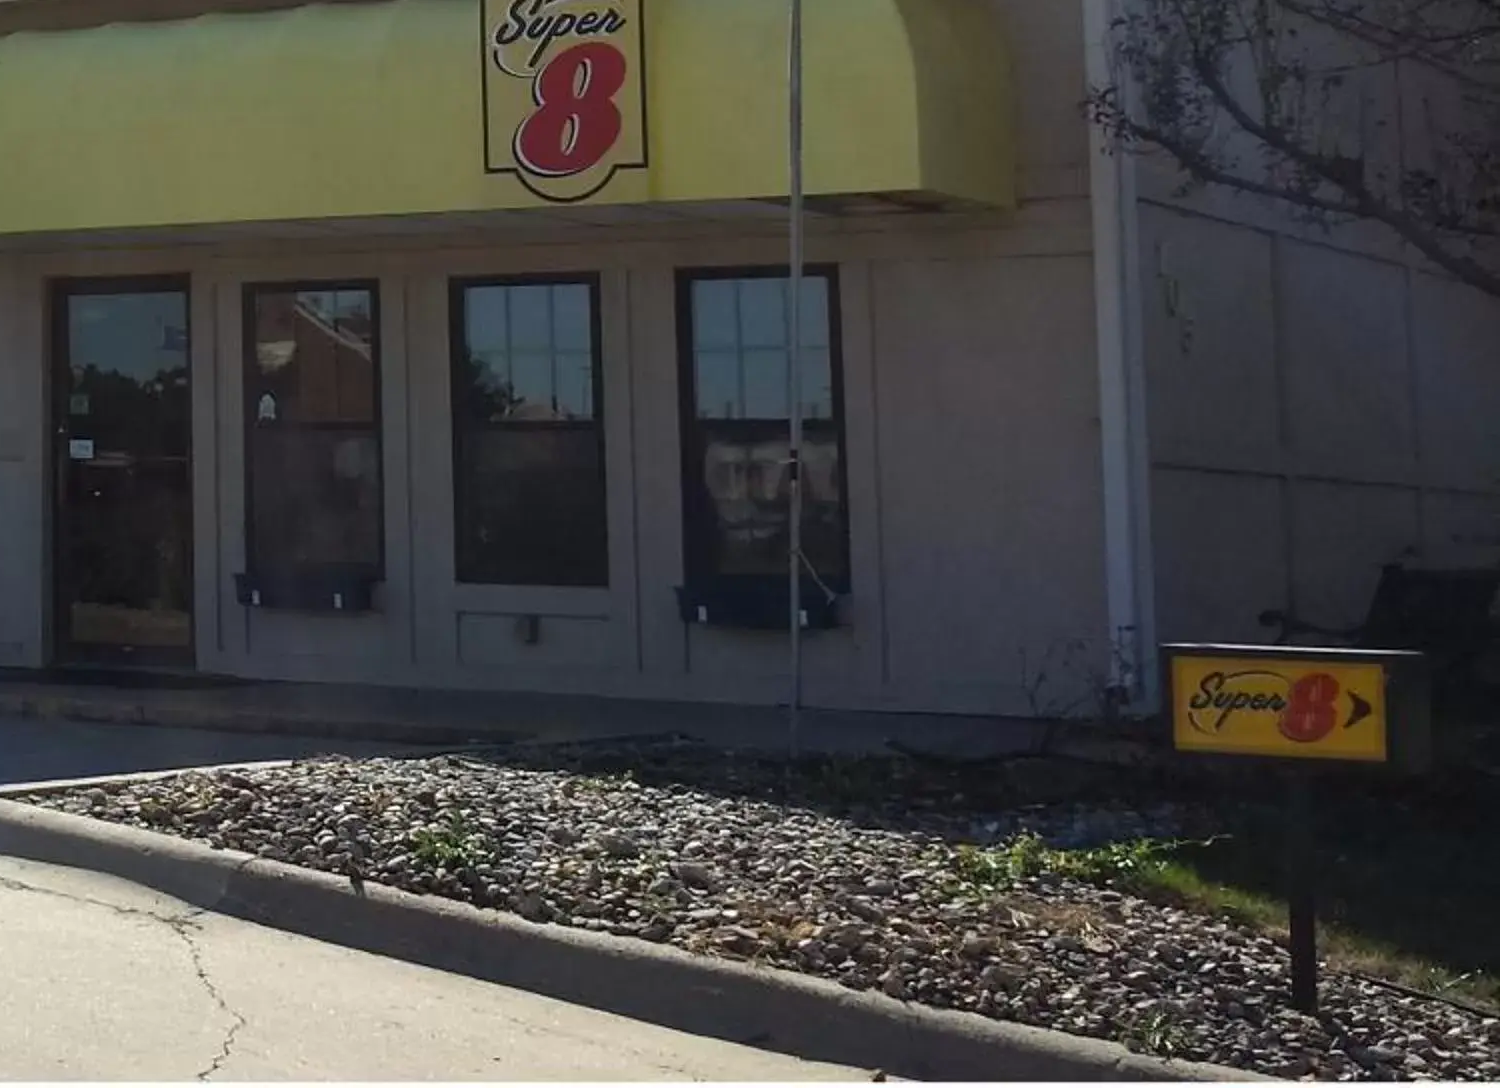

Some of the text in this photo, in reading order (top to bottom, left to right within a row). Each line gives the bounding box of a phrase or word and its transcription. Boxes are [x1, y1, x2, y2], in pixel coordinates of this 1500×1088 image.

[513, 41, 627, 177] 8
[1189, 671, 1340, 743] Super 8
